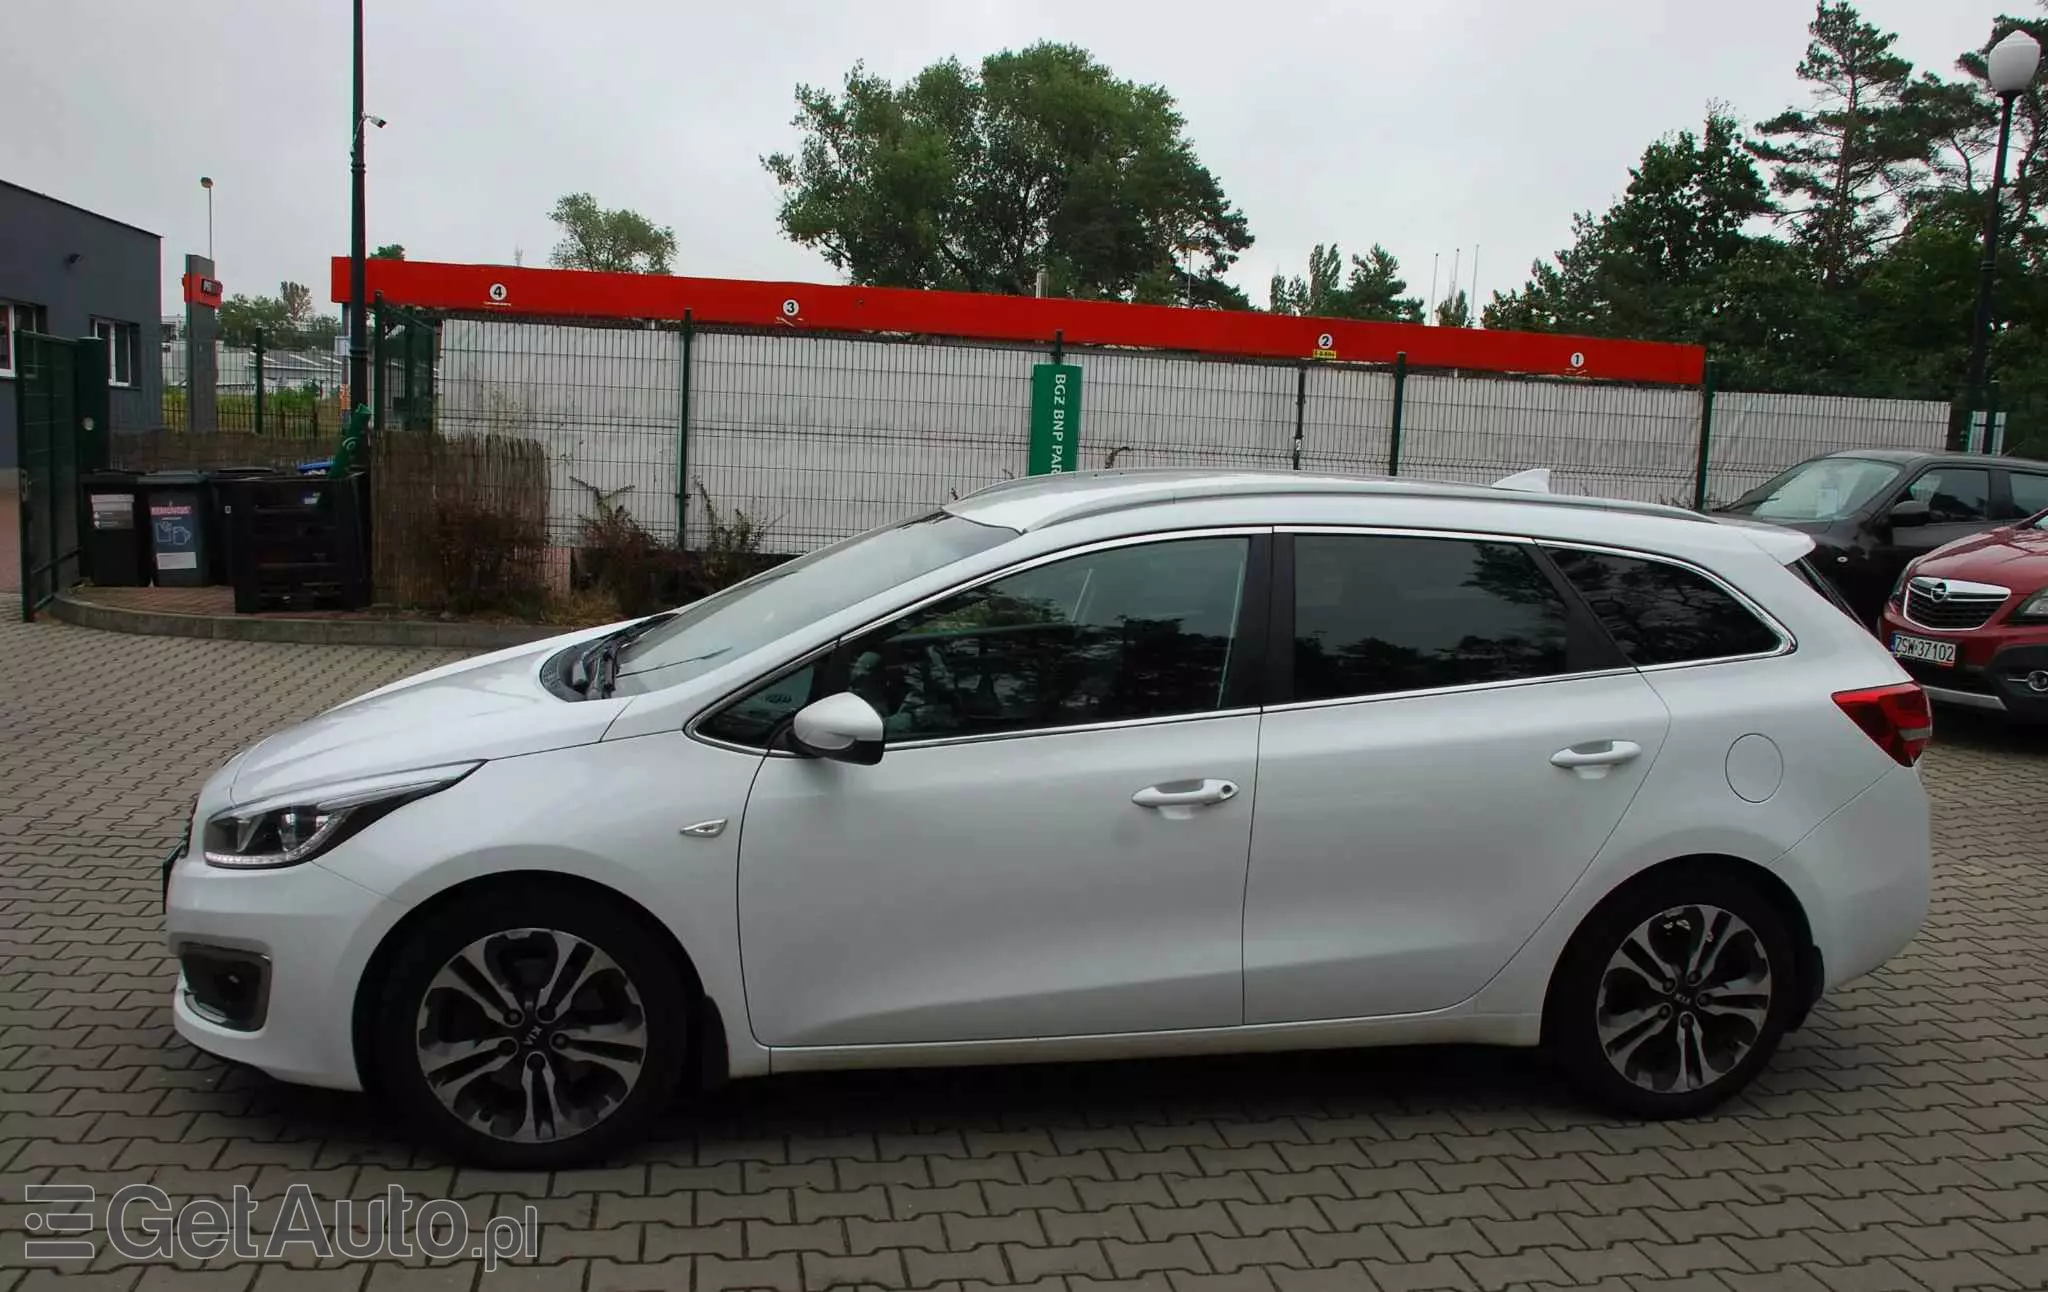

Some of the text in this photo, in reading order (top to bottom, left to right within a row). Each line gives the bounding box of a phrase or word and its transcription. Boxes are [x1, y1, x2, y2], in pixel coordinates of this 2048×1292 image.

[493, 285, 503, 298] 4
[786, 301, 796, 314] 3
[1321, 335, 1330, 347] 2
[1052, 409, 1065, 442] BNP
[1917, 641, 1955, 662] 37102
[521, 1025, 543, 1045] KIA
